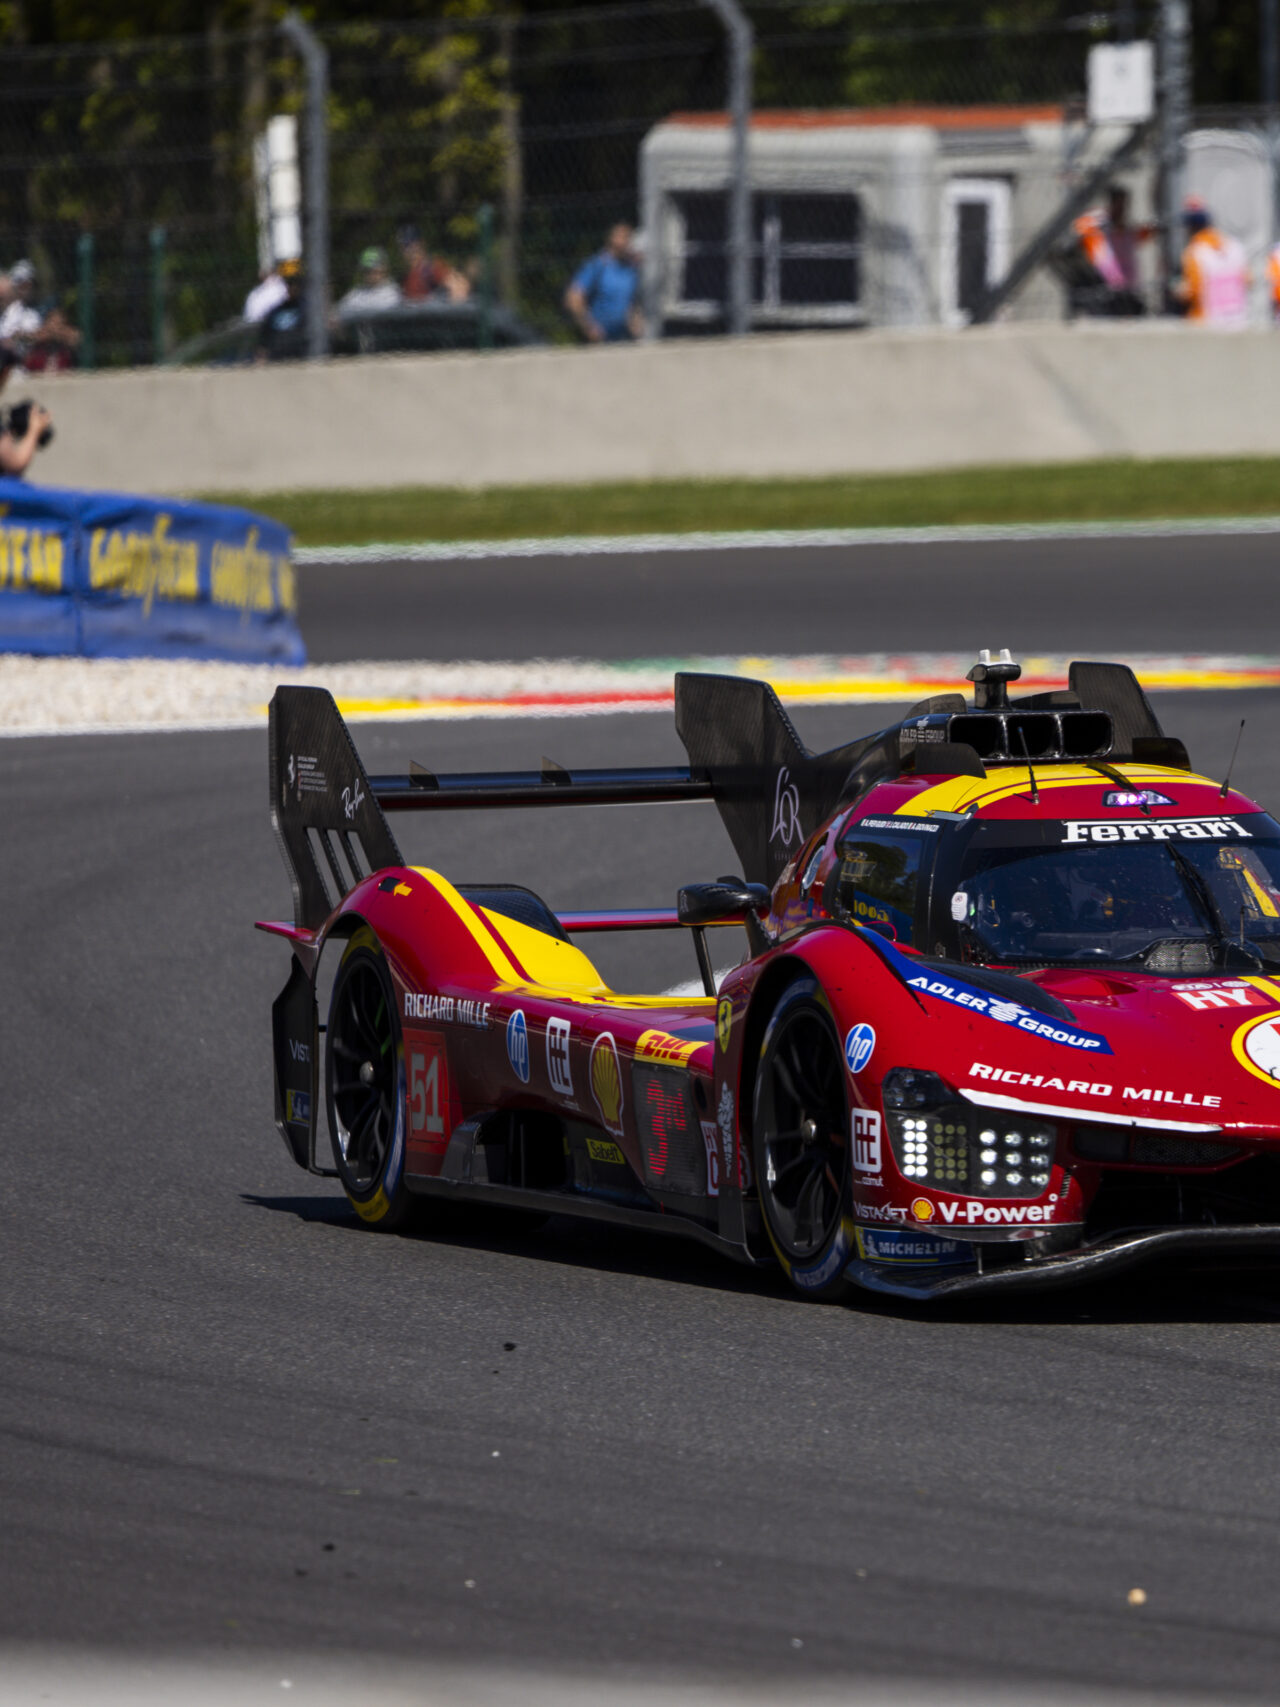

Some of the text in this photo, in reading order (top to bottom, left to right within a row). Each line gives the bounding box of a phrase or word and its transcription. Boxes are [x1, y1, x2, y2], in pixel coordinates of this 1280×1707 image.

[1061, 817, 1253, 843] Ferrari
[405, 993, 491, 1026] RICHARD MILLE
[907, 976, 1101, 1049] ADLER GROUP
[1177, 988, 1253, 1009] HY
[848, 1024, 873, 1072] hp
[411, 1053, 444, 1133] 51
[968, 1062, 1222, 1107] RICHARD MILLE
[938, 1201, 1055, 1224] V-Power
